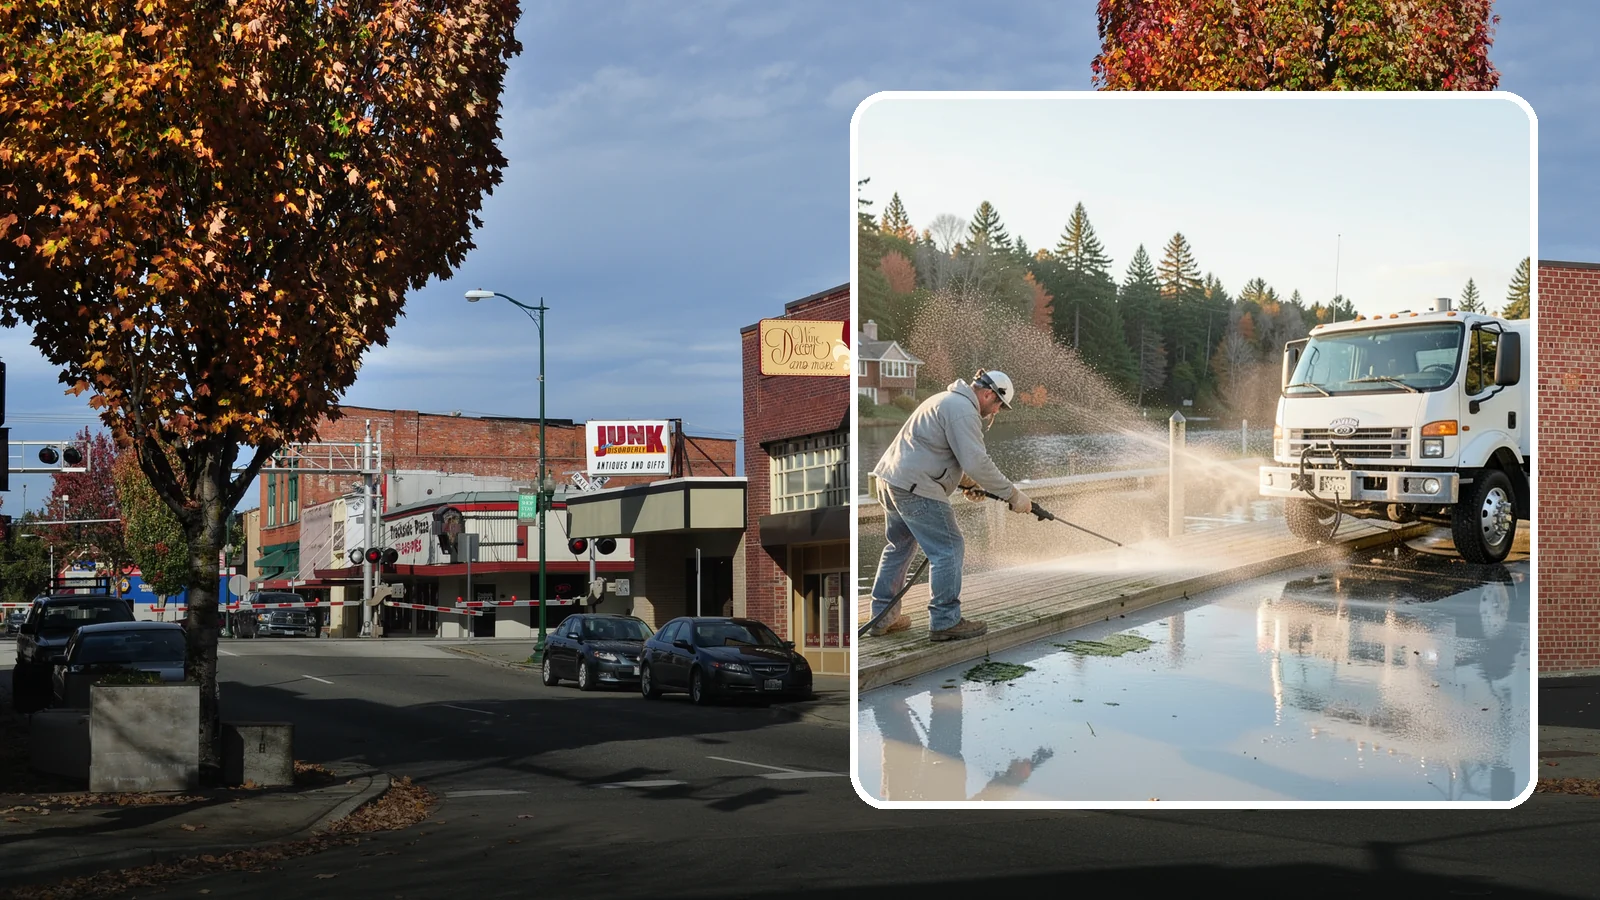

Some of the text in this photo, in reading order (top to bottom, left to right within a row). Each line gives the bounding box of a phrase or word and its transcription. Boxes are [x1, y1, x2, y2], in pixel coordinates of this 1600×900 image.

[595, 425, 665, 457] JUNK
[607, 446, 646, 454] DISORDERLY
[596, 460, 665, 470] ANTIQUES AND GIFTS
[573, 473, 589, 491] RAIL
[352, 498, 365, 511] CRO
